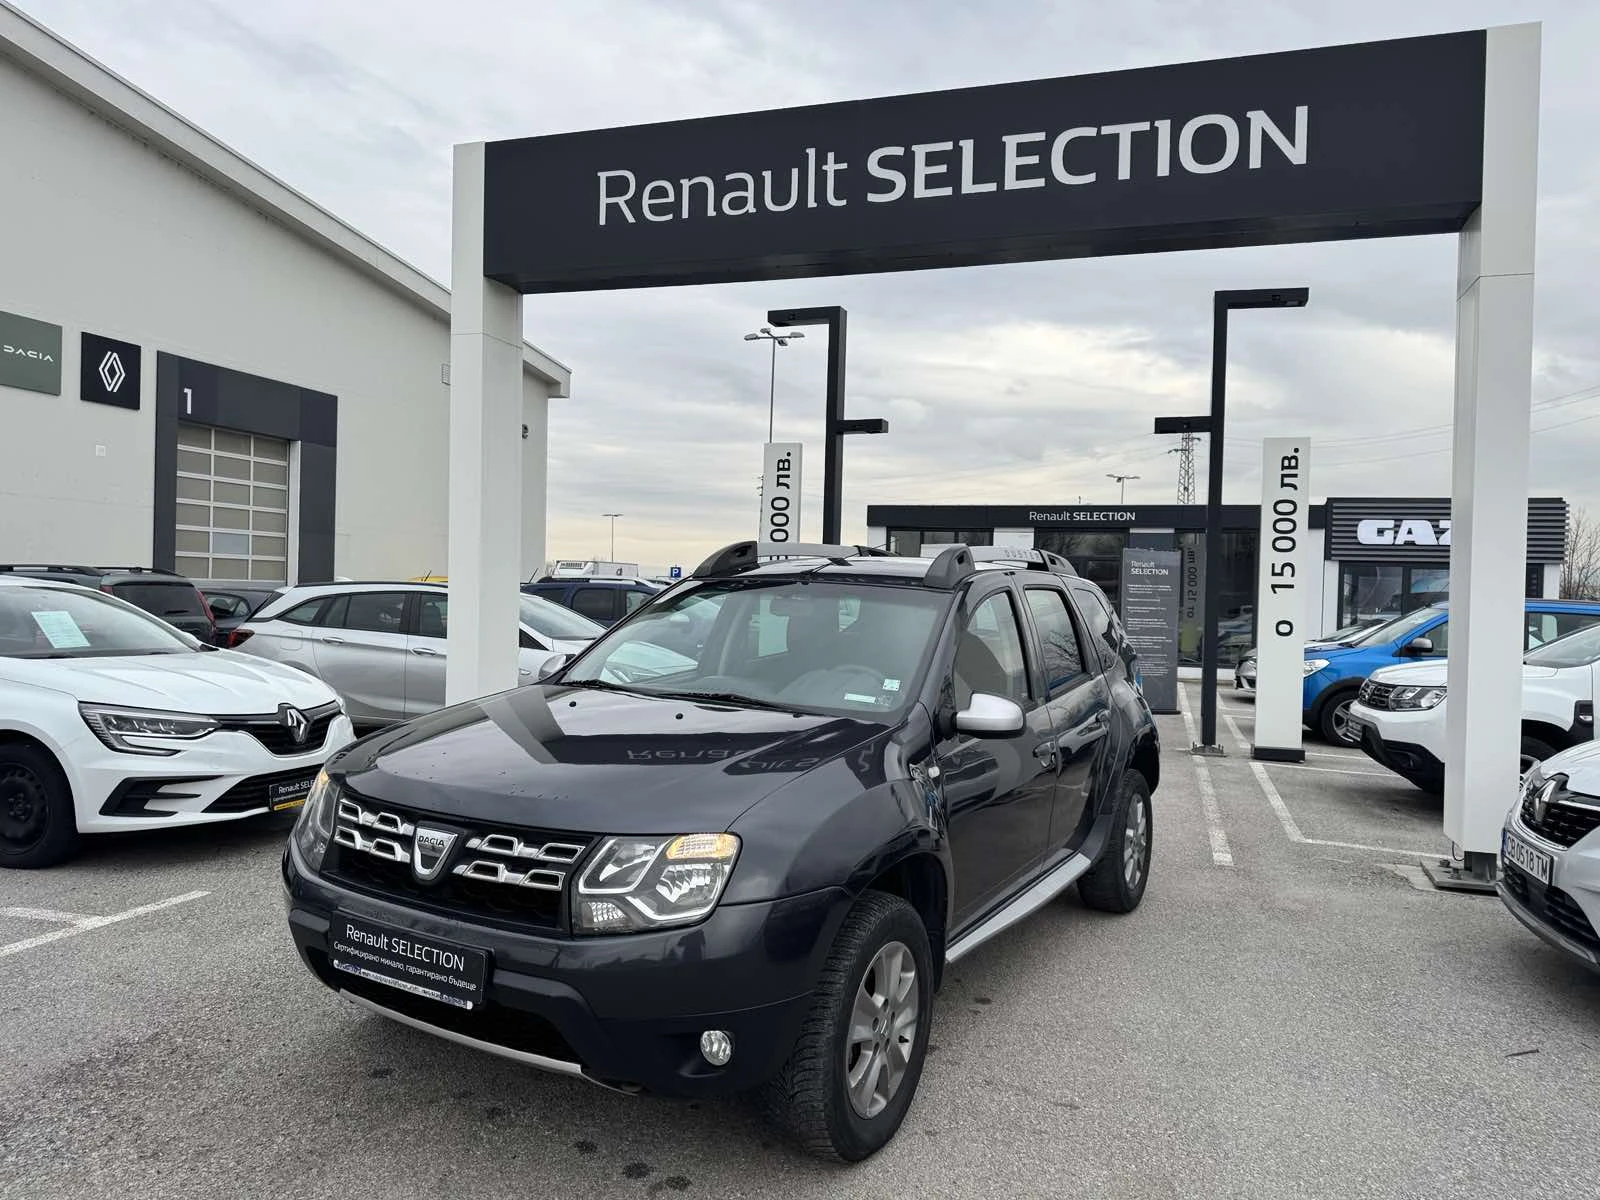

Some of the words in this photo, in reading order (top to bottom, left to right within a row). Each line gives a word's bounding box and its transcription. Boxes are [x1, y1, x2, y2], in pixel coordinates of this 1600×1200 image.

[597, 147, 849, 226] Renault
[866, 105, 1309, 203] SELECTION
[183, 388, 192, 415] 1
[776, 451, 792, 490] лв.
[1280, 447, 1300, 491] лв.
[1029, 511, 1071, 521] Renault
[1073, 511, 1136, 521] SELECTION
[1271, 499, 1298, 553] 000
[672, 568, 680, 577] P
[1131, 560, 1155, 568] Renault
[1131, 568, 1169, 576] SELECTION
[1270, 561, 1296, 595] 15
[418, 835, 445, 847] DACIA
[346, 924, 388, 950] Renault
[391, 938, 465, 972] SELECTION
[333, 941, 380, 963] Сертифицирано
[405, 964, 448, 983] гарантирано
[448, 974, 477, 991] бъдеще
